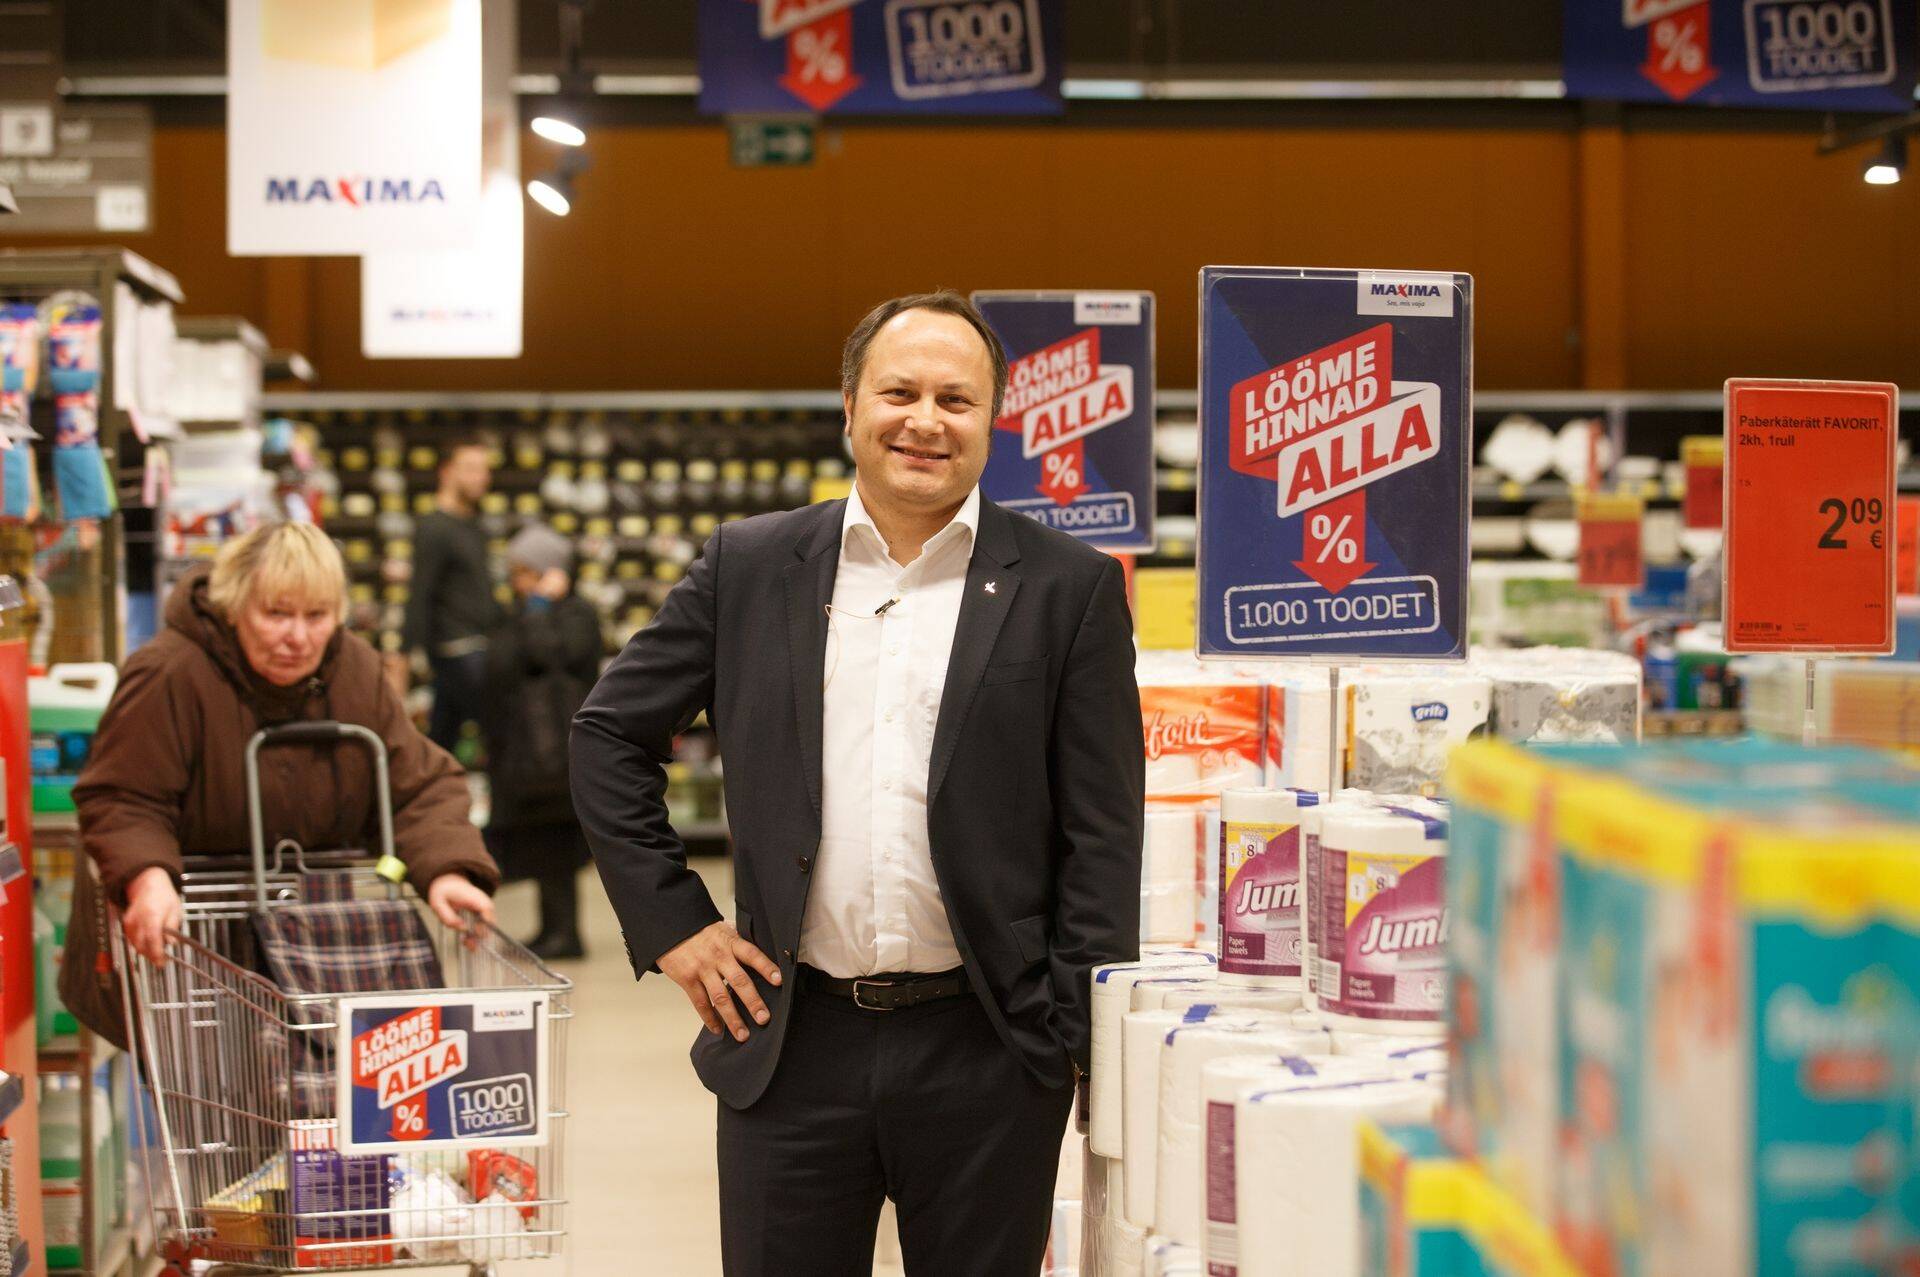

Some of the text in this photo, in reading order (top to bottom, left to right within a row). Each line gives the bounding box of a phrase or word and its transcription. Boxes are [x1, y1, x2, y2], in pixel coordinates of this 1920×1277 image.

[905, 3, 1024, 53] 1000
[1762, 4, 1875, 51] 1000
[266, 177, 446, 208] MAXIMA
[1370, 283, 1441, 298] MAXIMA
[1013, 338, 1090, 388] ÖÖME
[1245, 341, 1377, 423] LÖÖME
[1029, 382, 1126, 449] ALLA
[1245, 376, 1379, 456] HINNAD
[1739, 415, 1883, 431] Paberkäterätt FAVORIT,
[1285, 403, 1433, 507] ALLA
[1048, 502, 1126, 527] TOODET
[1238, 592, 1427, 628] 1000 TOODET
[359, 1009, 433, 1058] LÖÖME
[359, 1028, 435, 1077] HINNAD
[384, 1043, 463, 1102] ALLA
[458, 1083, 524, 1115] 1000
[460, 1106, 525, 1130] TOODET
